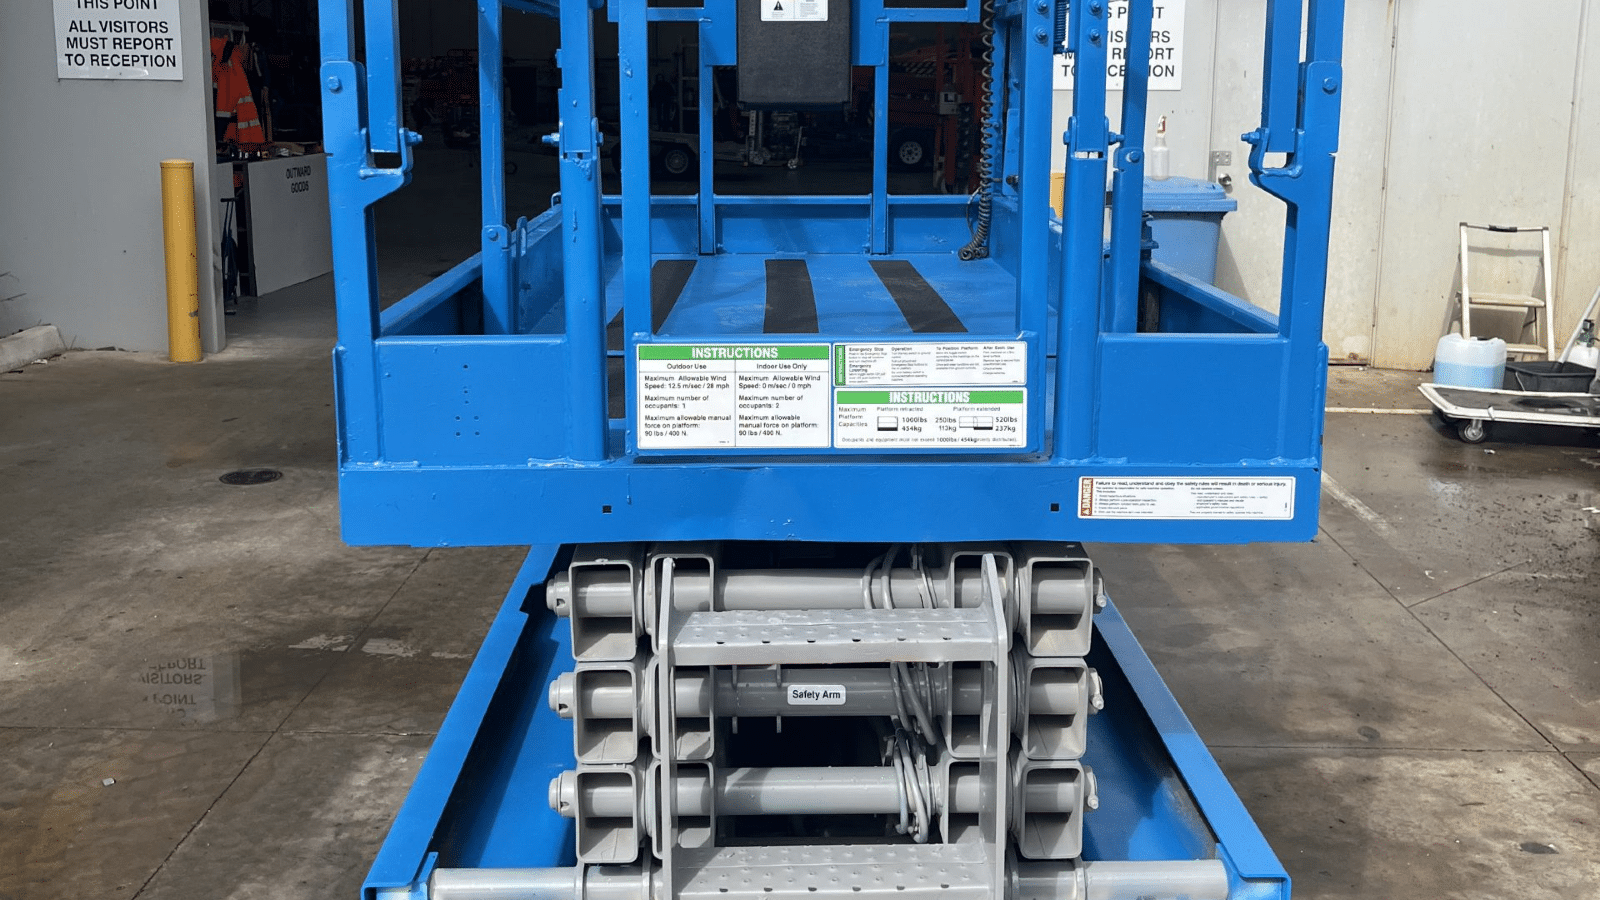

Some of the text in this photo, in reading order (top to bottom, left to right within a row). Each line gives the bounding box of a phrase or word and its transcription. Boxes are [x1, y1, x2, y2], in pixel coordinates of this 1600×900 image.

[77, 0, 157, 9] THIS POINT
[68, 20, 169, 33] ALL VISITORS
[66, 37, 174, 50] MUST REPORT
[64, 53, 176, 67] TO RECEPTION
[286, 165, 312, 179] OUTWARD
[291, 180, 310, 194] GOODS
[692, 347, 778, 358] INSTRUCTIONS
[890, 392, 970, 403] INSTRUCTIONS
[1082, 479, 1092, 508] DANGER
[792, 690, 841, 700] Safety Arm
